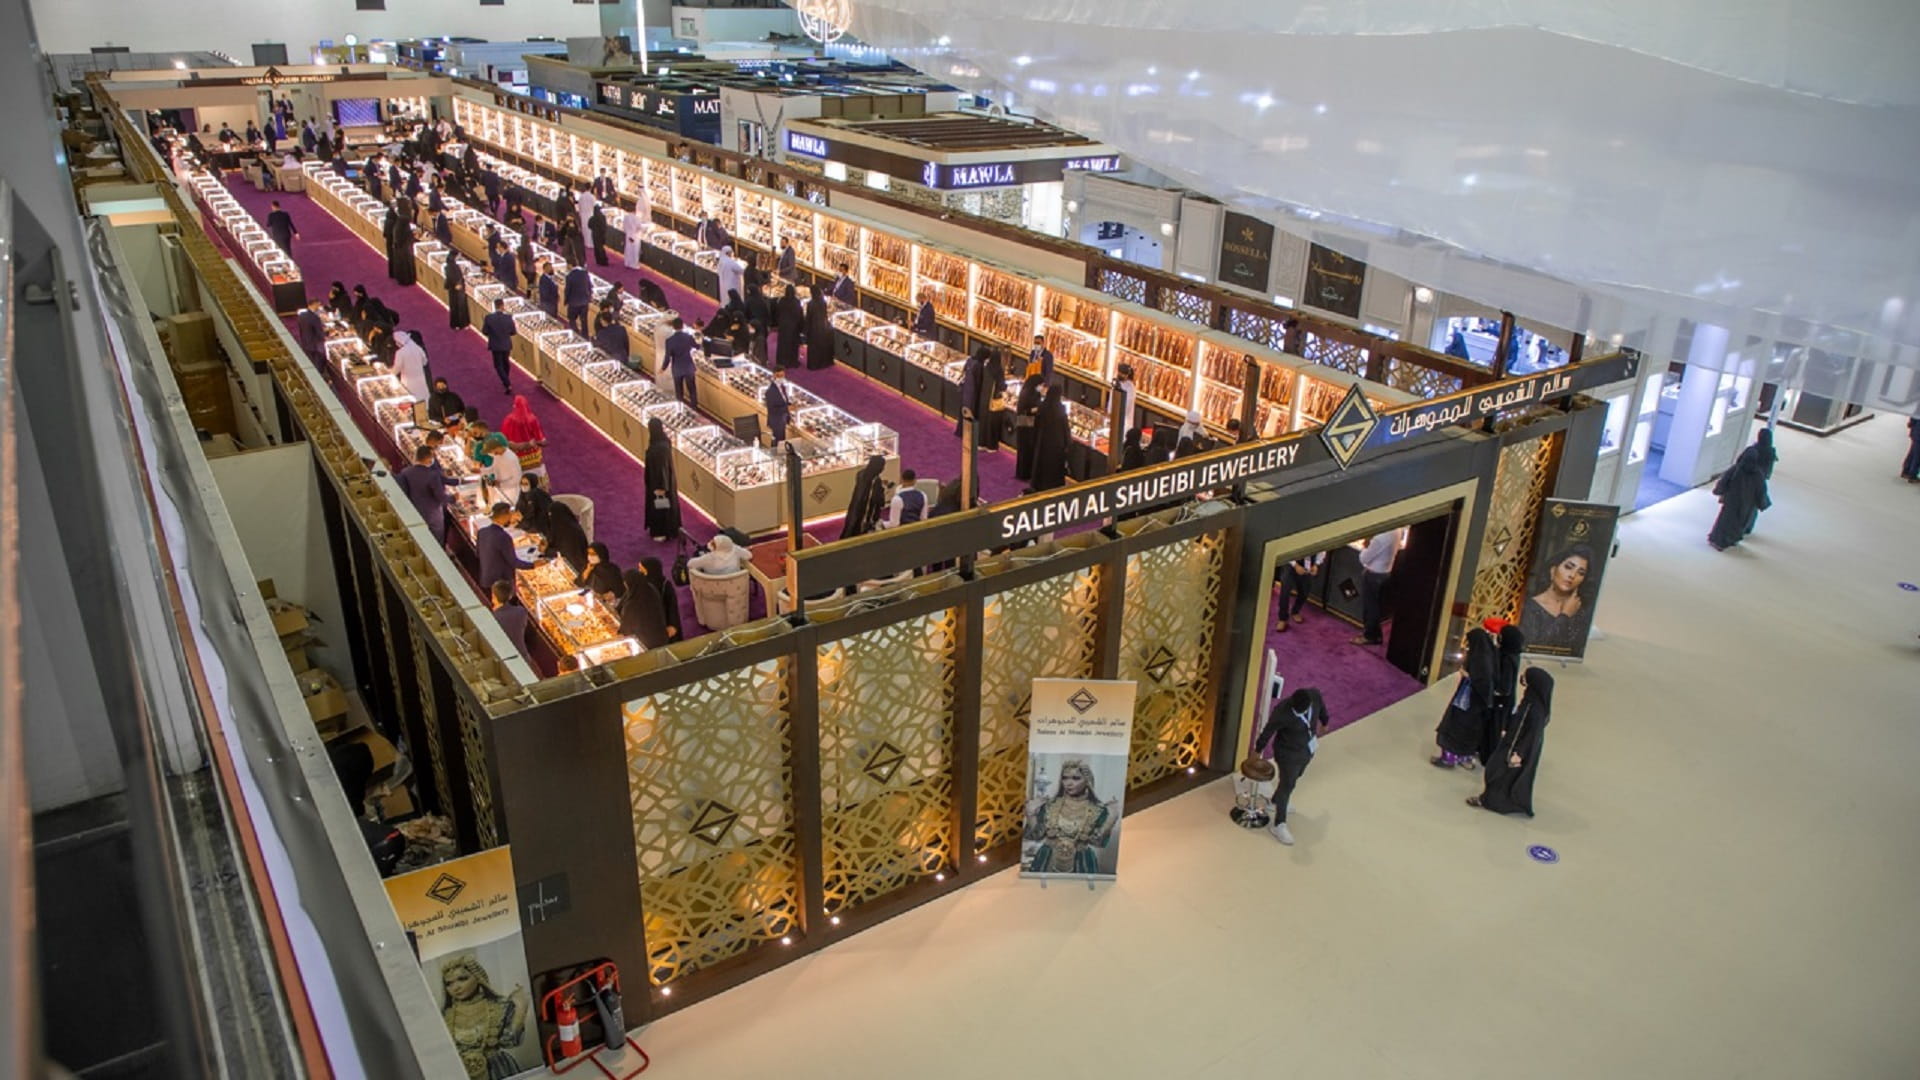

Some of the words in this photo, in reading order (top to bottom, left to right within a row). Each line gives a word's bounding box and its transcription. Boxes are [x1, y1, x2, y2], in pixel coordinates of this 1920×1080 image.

[791, 132, 826, 156] MAWLA
[952, 164, 1015, 186] MAWLA
[1478, 379, 1536, 412] الشعيبي
[1539, 373, 1572, 401] سالم
[1389, 396, 1473, 438] للمجوهرات
[1001, 499, 1079, 539] SALEM
[1084, 493, 1110, 517] AL
[1115, 473, 1195, 509] SHUEIBI
[1198, 444, 1300, 488] JEWELLERY
